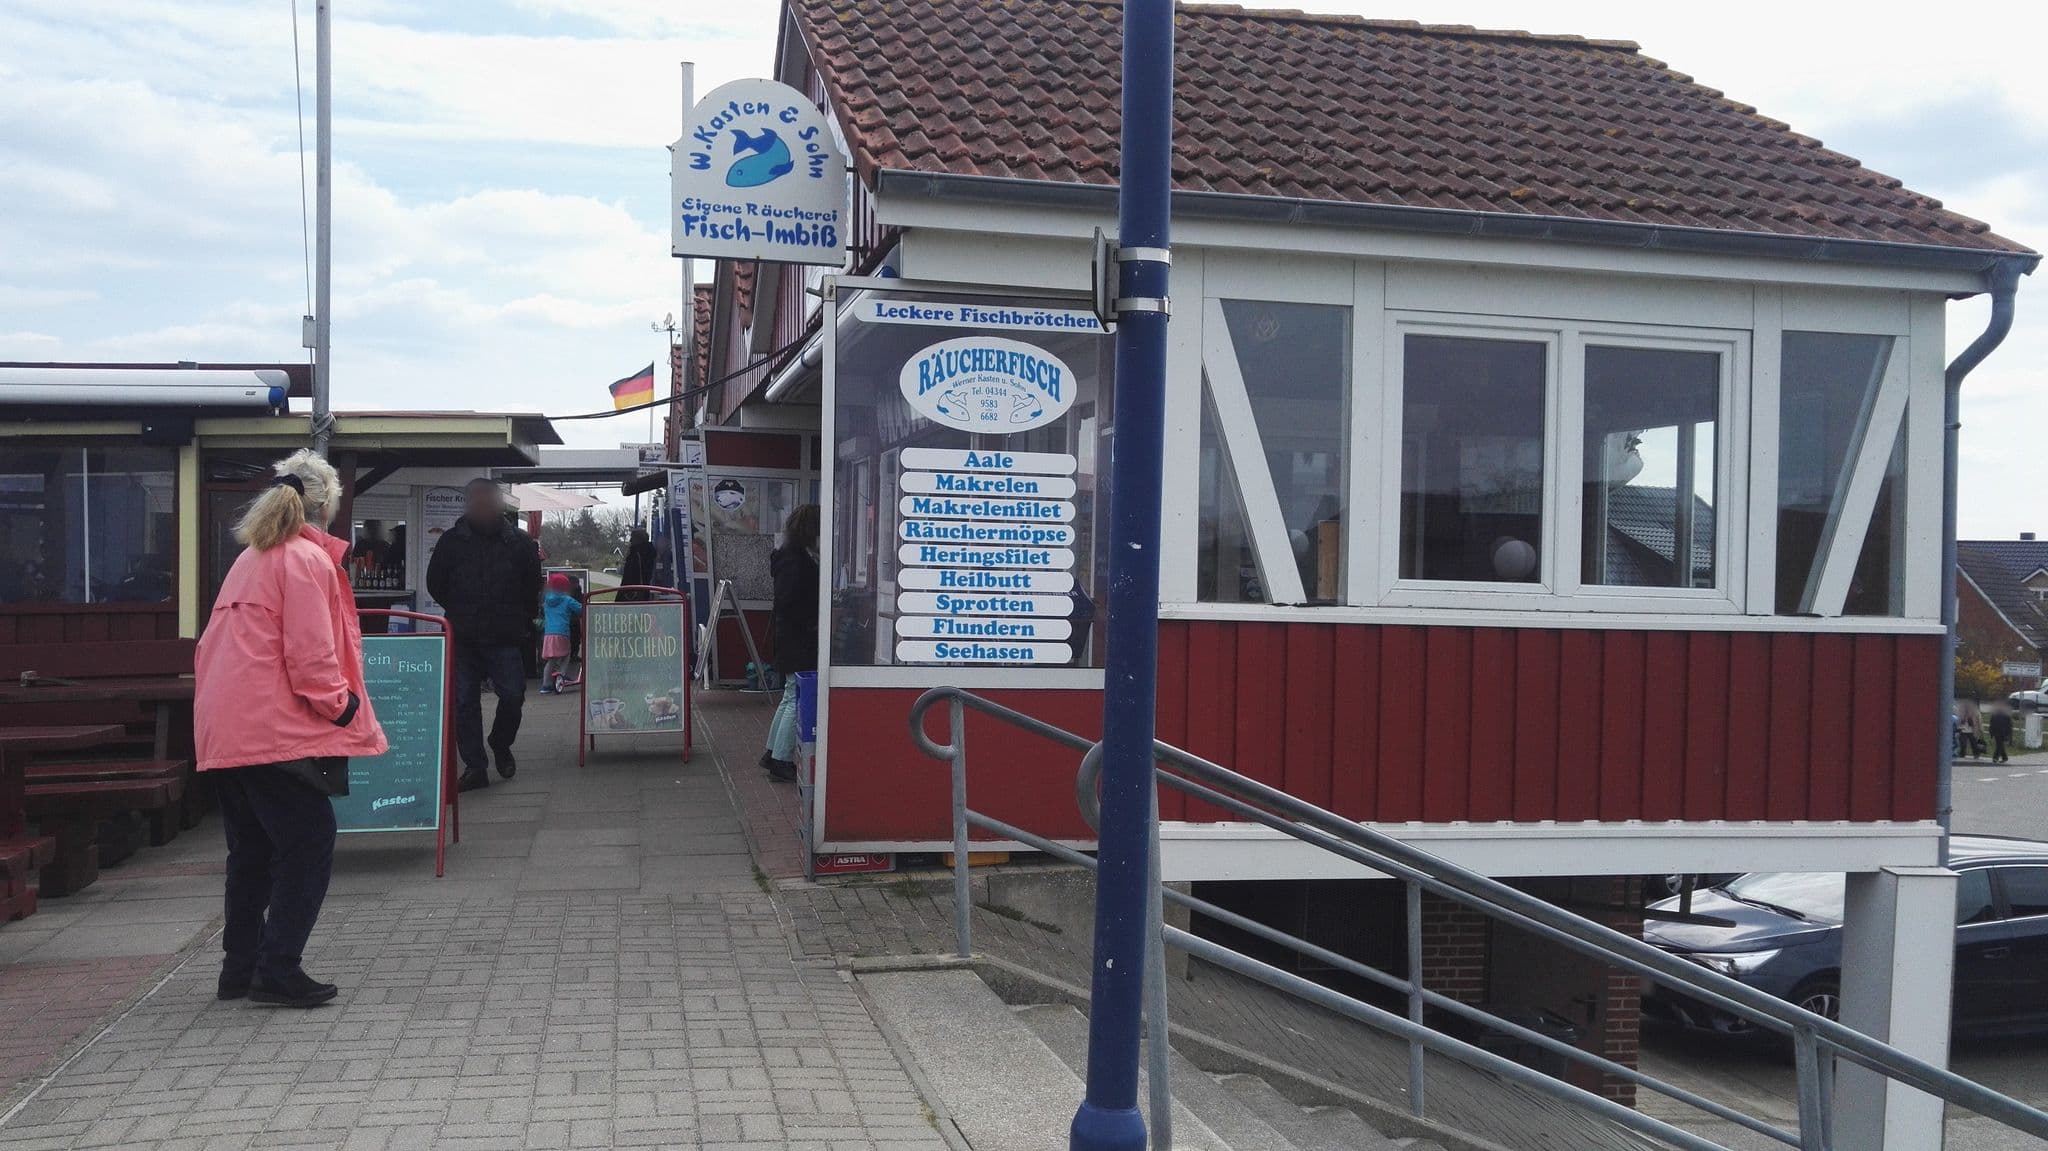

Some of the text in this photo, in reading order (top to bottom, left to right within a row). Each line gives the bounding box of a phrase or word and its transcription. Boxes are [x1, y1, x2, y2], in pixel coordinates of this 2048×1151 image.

[799, 126, 829, 179] Sohn
[681, 197, 838, 222] Eigene Räucherei
[681, 213, 838, 248] Fisch-Imbiß
[876, 303, 1099, 329] Leckere Fischbrötchen
[918, 348, 1062, 403] RÄUCHERFISCH
[952, 376, 976, 389] Werner
[977, 373, 1000, 383] Kasten
[972, 387, 1007, 397] Tel. 04344
[980, 400, 998, 409] 9583
[980, 412, 998, 421] 6682
[964, 452, 1013, 469] Aale
[935, 474, 1039, 493] Makrelen
[912, 498, 1062, 519] Makrelenfilet
[905, 522, 1067, 544] Räuchermöpse
[920, 546, 1050, 567] Heringsfilet
[939, 571, 1032, 588] Heilbutt
[936, 595, 1034, 615] Sprotten
[594, 613, 651, 634] BELEBEND
[932, 618, 1035, 637] Flundern
[594, 636, 677, 658] ERFRISCHEND
[935, 643, 1034, 660] Seehasen
[398, 660, 433, 673] Fisch
[372, 795, 416, 811] Kasten
[836, 855, 866, 865] ASTRA
